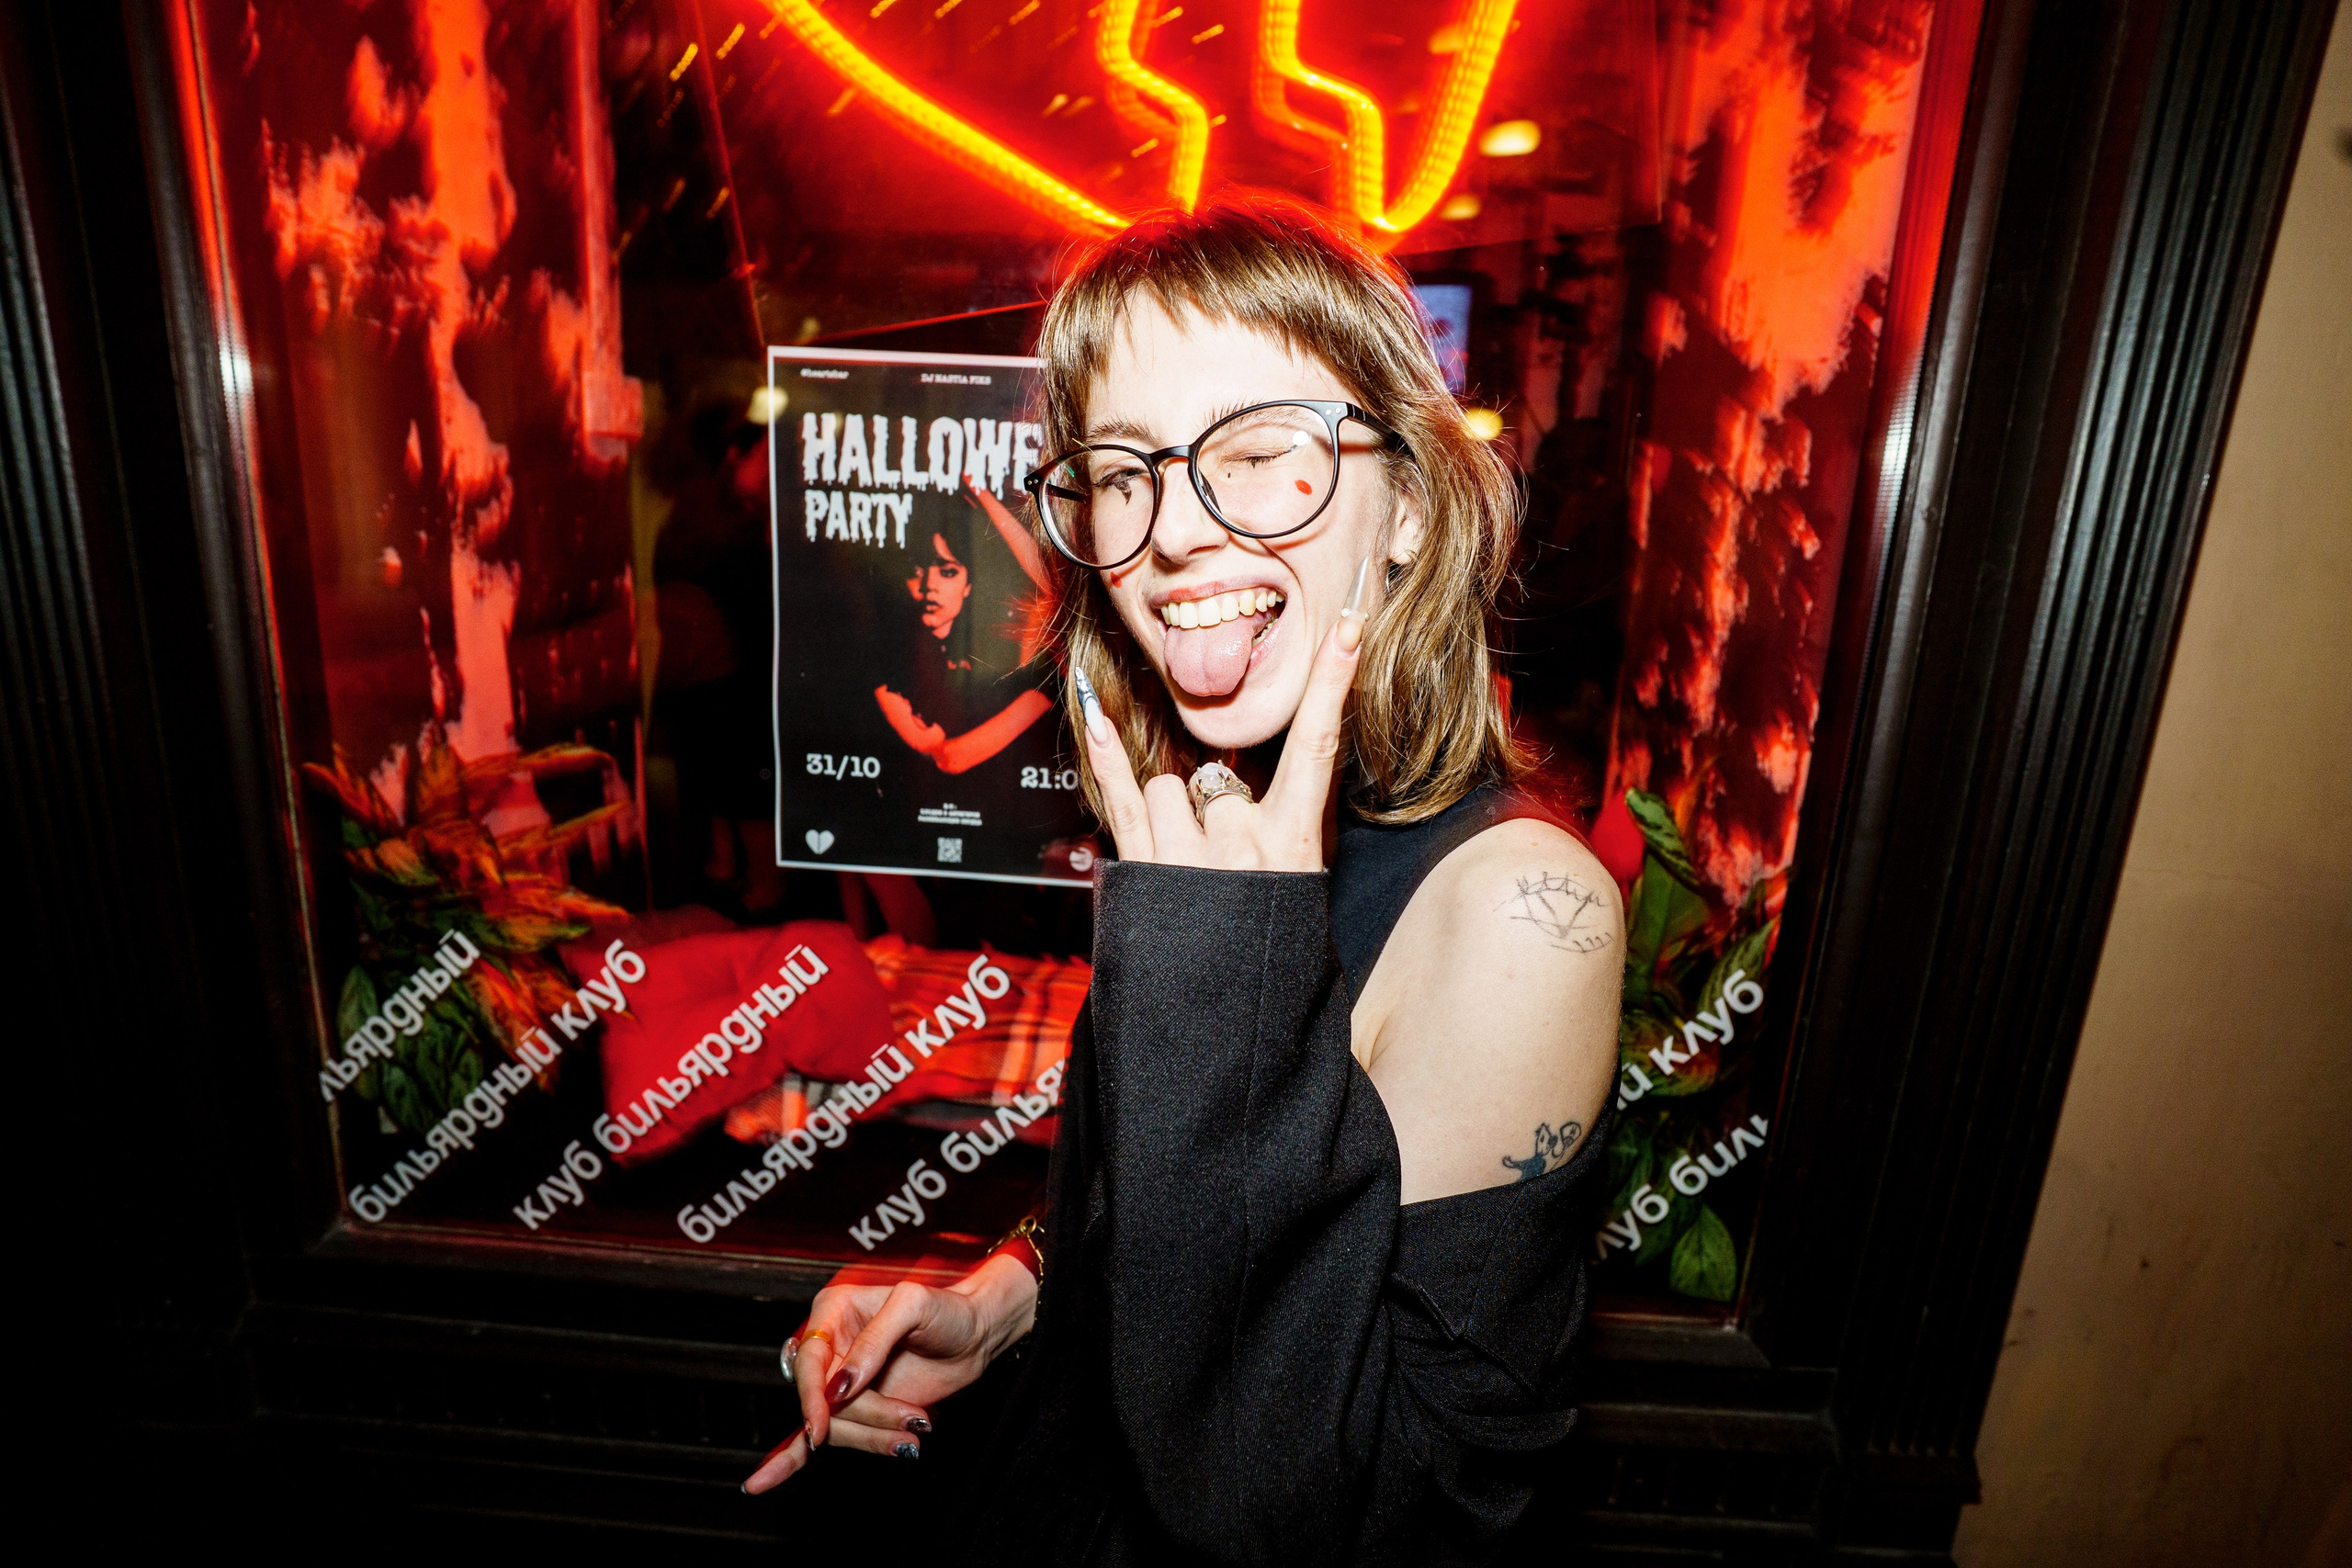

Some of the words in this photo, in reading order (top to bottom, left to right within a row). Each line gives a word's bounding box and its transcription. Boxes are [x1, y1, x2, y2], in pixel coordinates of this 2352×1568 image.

[921, 373, 934, 383] DJ
[804, 490, 913, 549] PARTY
[806, 753, 881, 781] 31/10
[1021, 766, 1082, 791] 21:0
[1647, 968, 1765, 1077] клуб
[348, 1026, 563, 1224] бильярдный
[550, 939, 647, 1041] клуб
[512, 1139, 604, 1231] клуб
[592, 943, 831, 1155] бильярдный
[676, 1043, 915, 1244] бильярдный
[904, 953, 1011, 1058] клуб
[847, 1158, 948, 1251] клуб
[940, 1058, 1066, 1174] билья
[1590, 1183, 1670, 1266] луб
